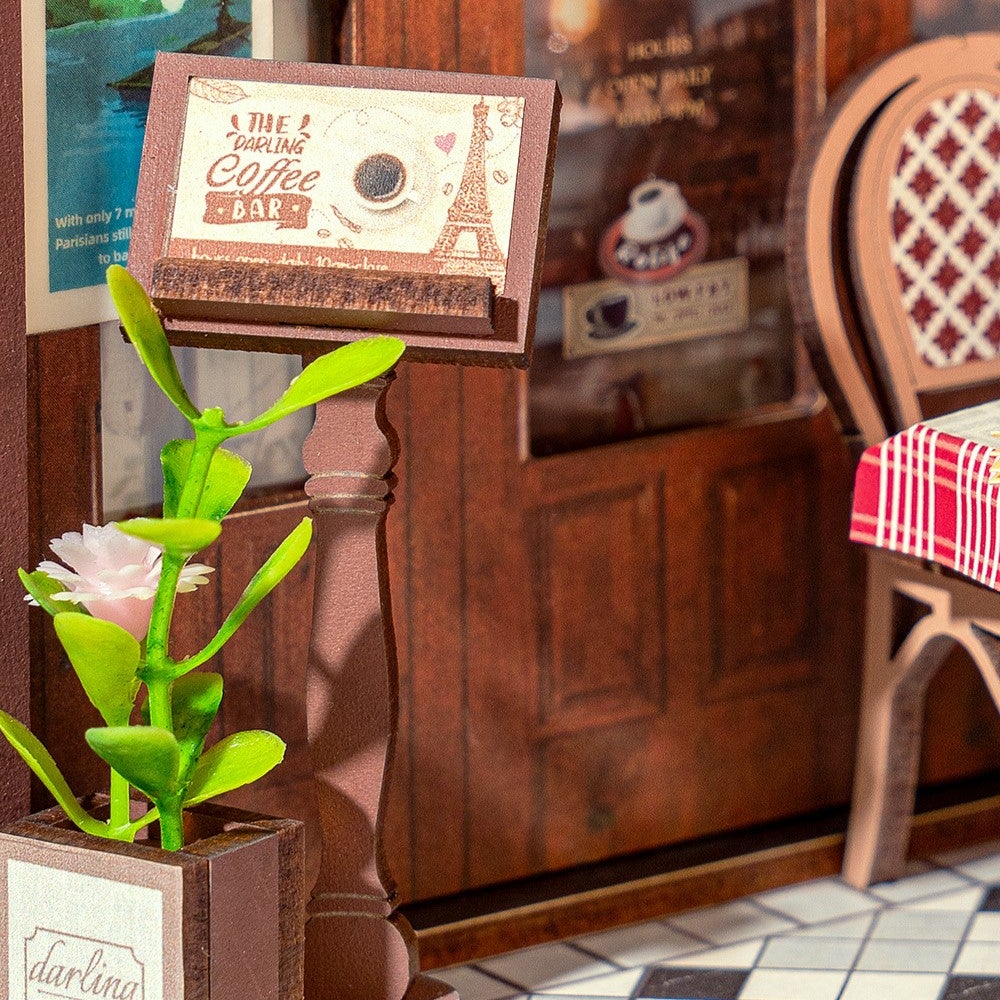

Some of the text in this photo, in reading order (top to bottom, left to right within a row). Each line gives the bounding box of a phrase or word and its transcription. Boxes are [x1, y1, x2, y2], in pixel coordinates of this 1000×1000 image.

[248, 112, 291, 134] THE
[233, 134, 306, 155] DARLING
[206, 153, 321, 195] Coffee
[55, 213, 83, 228] With
[86, 210, 113, 224] only
[115, 207, 122, 219] 7
[231, 199, 283, 220] BAR
[56, 233, 109, 250] Parisians
[98, 253, 110, 264] to
[28, 940, 139, 1000] darling
